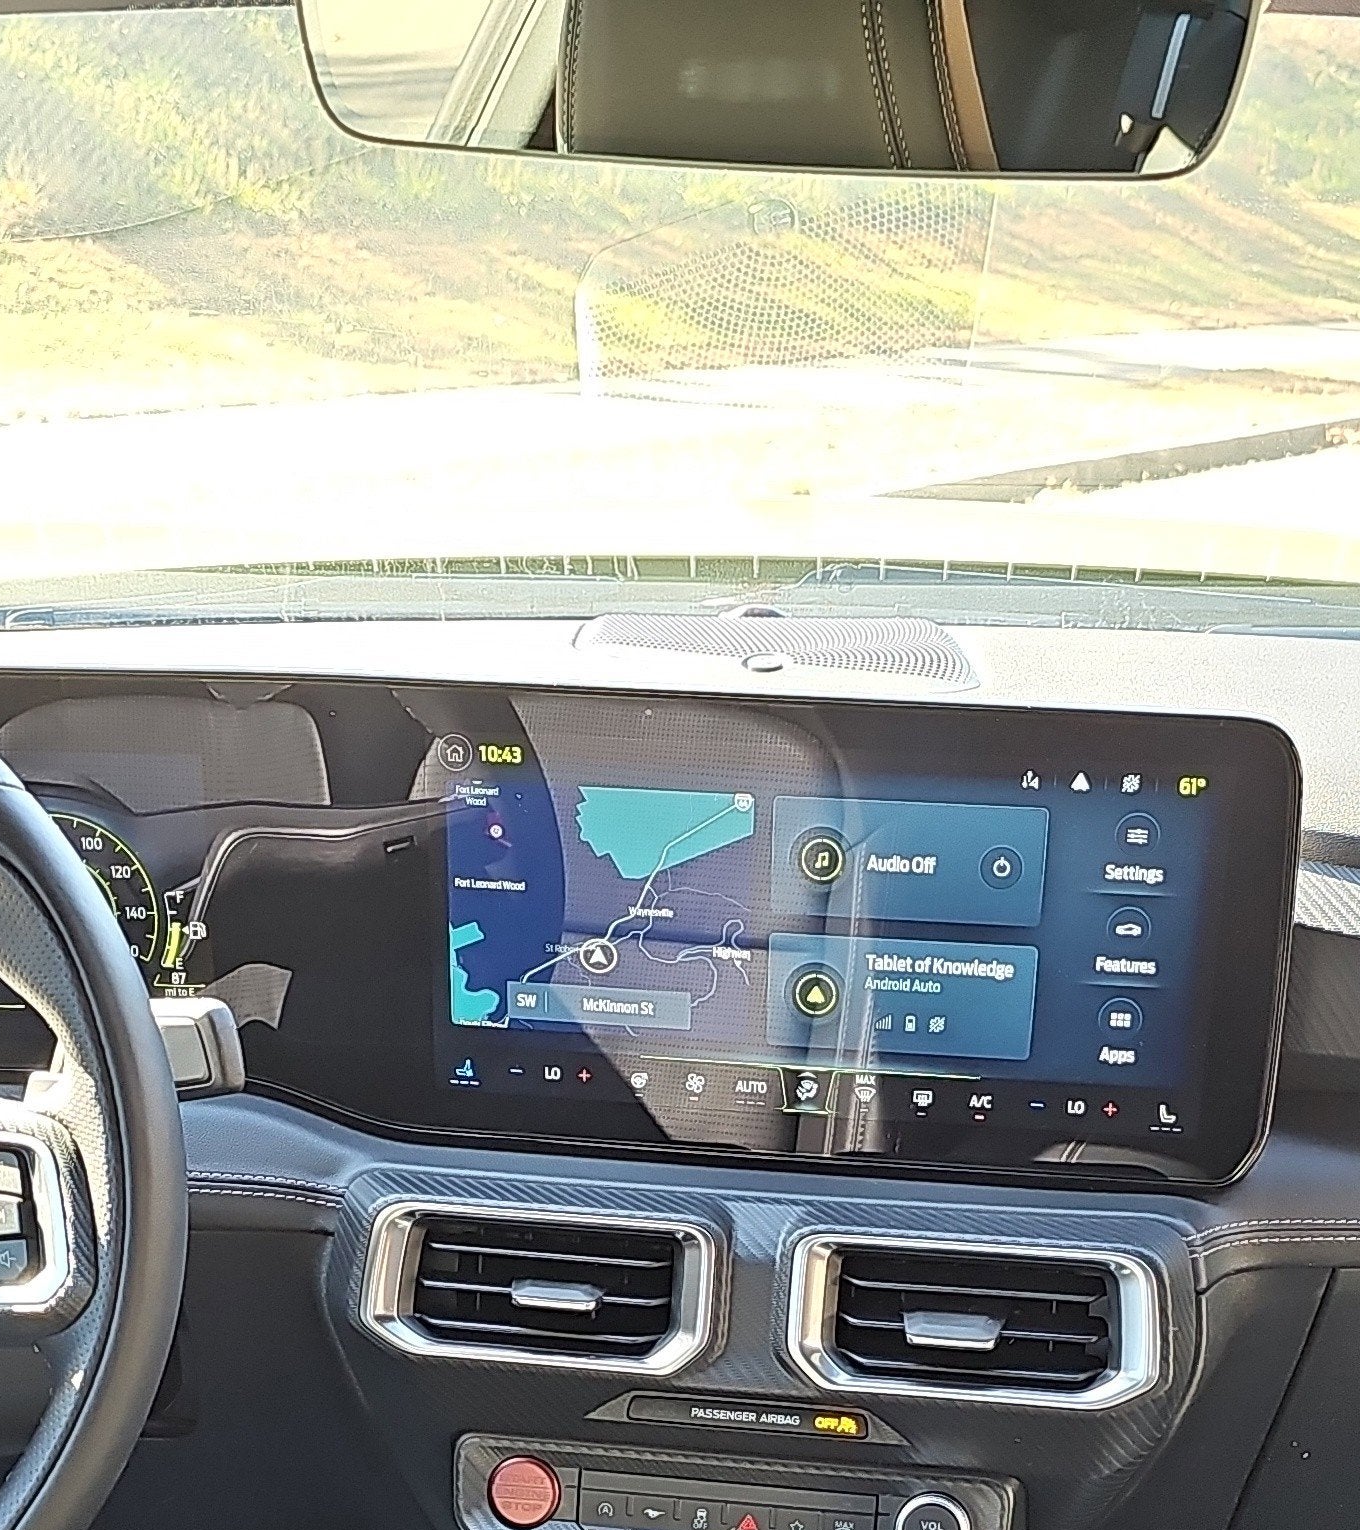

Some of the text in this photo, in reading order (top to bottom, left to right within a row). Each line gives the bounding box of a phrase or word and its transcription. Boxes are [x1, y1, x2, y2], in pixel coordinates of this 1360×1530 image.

[478, 745, 522, 764] 10:43
[80, 837, 103, 851] 100
[867, 854, 937, 874] Audio Off
[110, 866, 131, 879] 120
[1104, 863, 1164, 884] Settings
[125, 906, 146, 920] 140
[865, 954, 1015, 981] Tablet of Knowledge
[1095, 957, 1157, 976] Features
[171, 971, 187, 985] 87
[864, 976, 941, 993] Android Auto
[164, 987, 177, 997] mi
[177, 988, 188, 997] to
[516, 993, 537, 1009] SW
[582, 997, 655, 1016] McKinnon St
[1098, 1047, 1136, 1066] Apps
[544, 1066, 561, 1080] LO
[854, 1075, 876, 1086] MAX
[735, 1080, 768, 1094] AUTO
[969, 1095, 993, 1110] A/C
[1067, 1101, 1086, 1116] LO
[690, 1407, 801, 1426] PASSENGER AIRBAG
[814, 1417, 838, 1430] OFF
[501, 1500, 543, 1513] STOP
[834, 1520, 855, 1530] MAX
